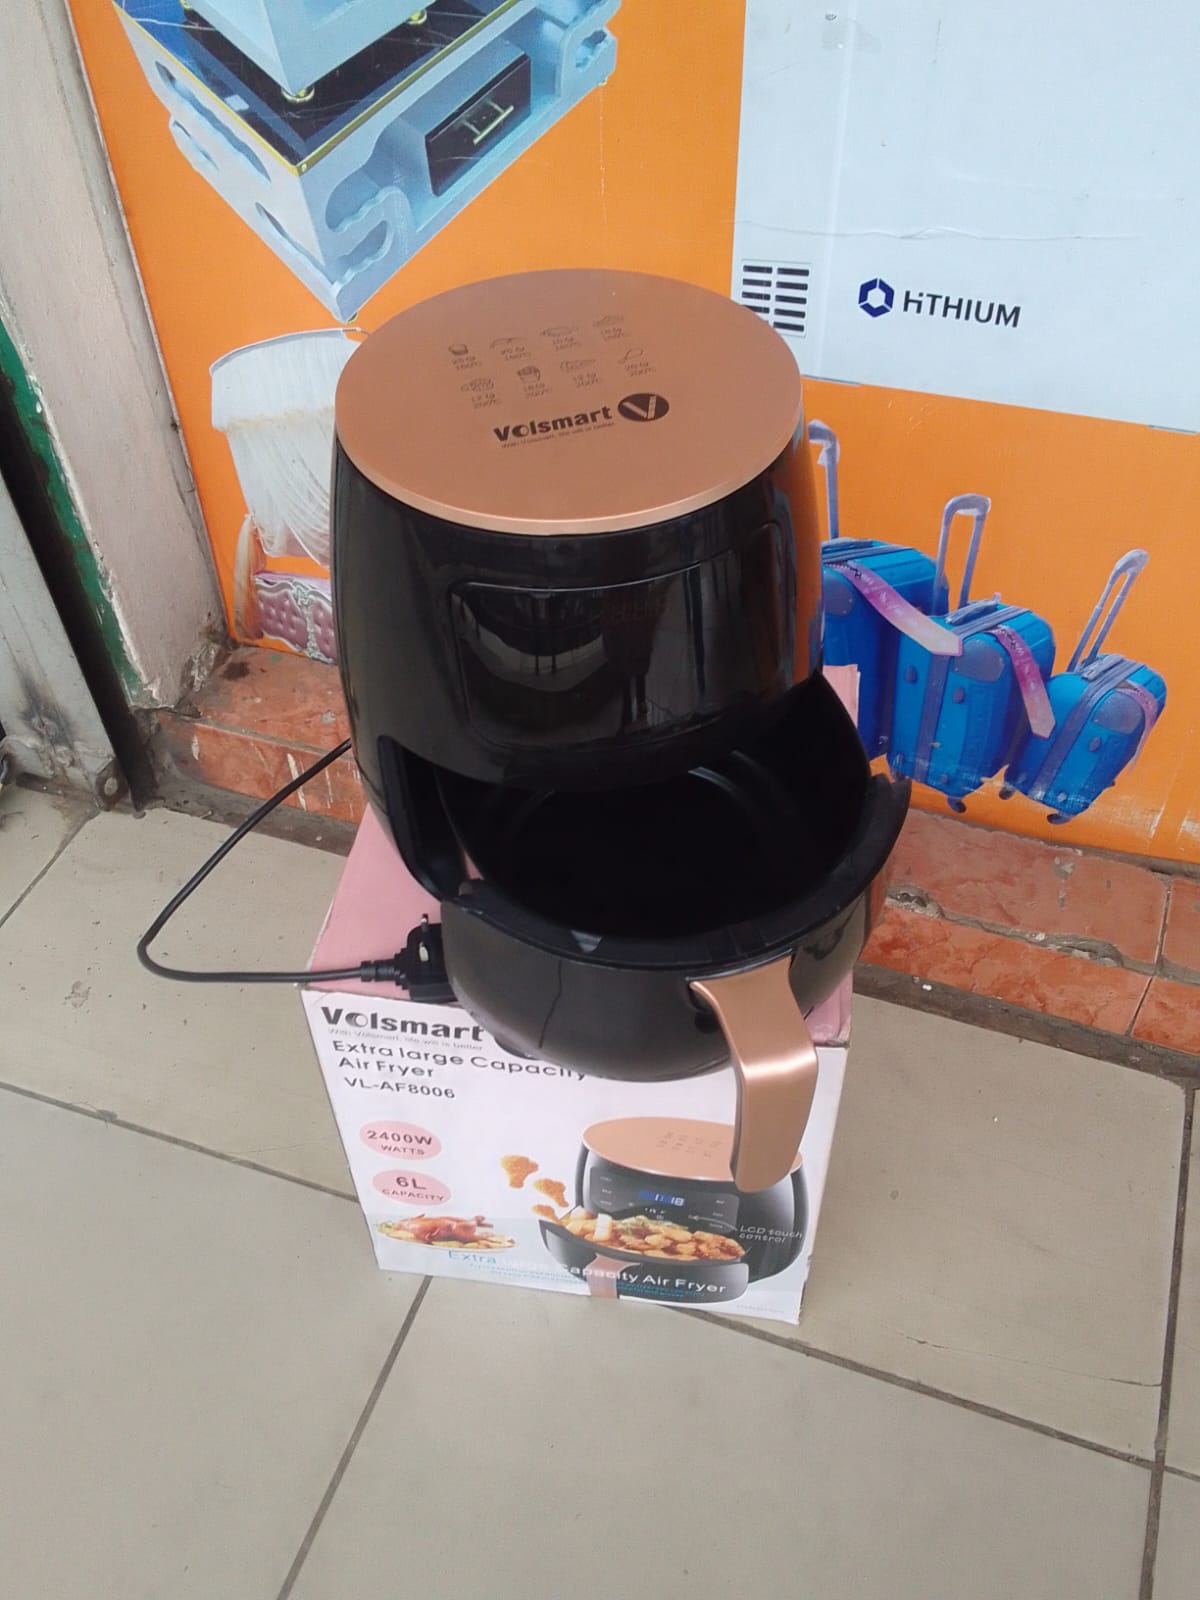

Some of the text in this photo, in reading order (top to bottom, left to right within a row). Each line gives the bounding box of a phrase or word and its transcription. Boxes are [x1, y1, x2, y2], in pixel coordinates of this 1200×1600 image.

[903, 290, 1021, 328] HiTHIUM
[494, 406, 613, 441] Volsmart
[321, 1006, 485, 1041] Volsmart
[332, 1040, 393, 1057] Extra
[400, 1047, 464, 1066] large
[339, 1057, 435, 1078] Air Fryer
[344, 1076, 455, 1099] VL-AF8006
[367, 1130, 432, 1146] 2400W
[380, 1144, 425, 1155] WATTS
[396, 1176, 427, 1190] 6L
[382, 1188, 444, 1202] CAPACITY
[739, 1233, 786, 1243] control
[740, 1224, 803, 1239] LCD touch
[448, 1250, 497, 1264] Extra
[642, 1274, 671, 1287] Air
[674, 1278, 727, 1294] Fryer
